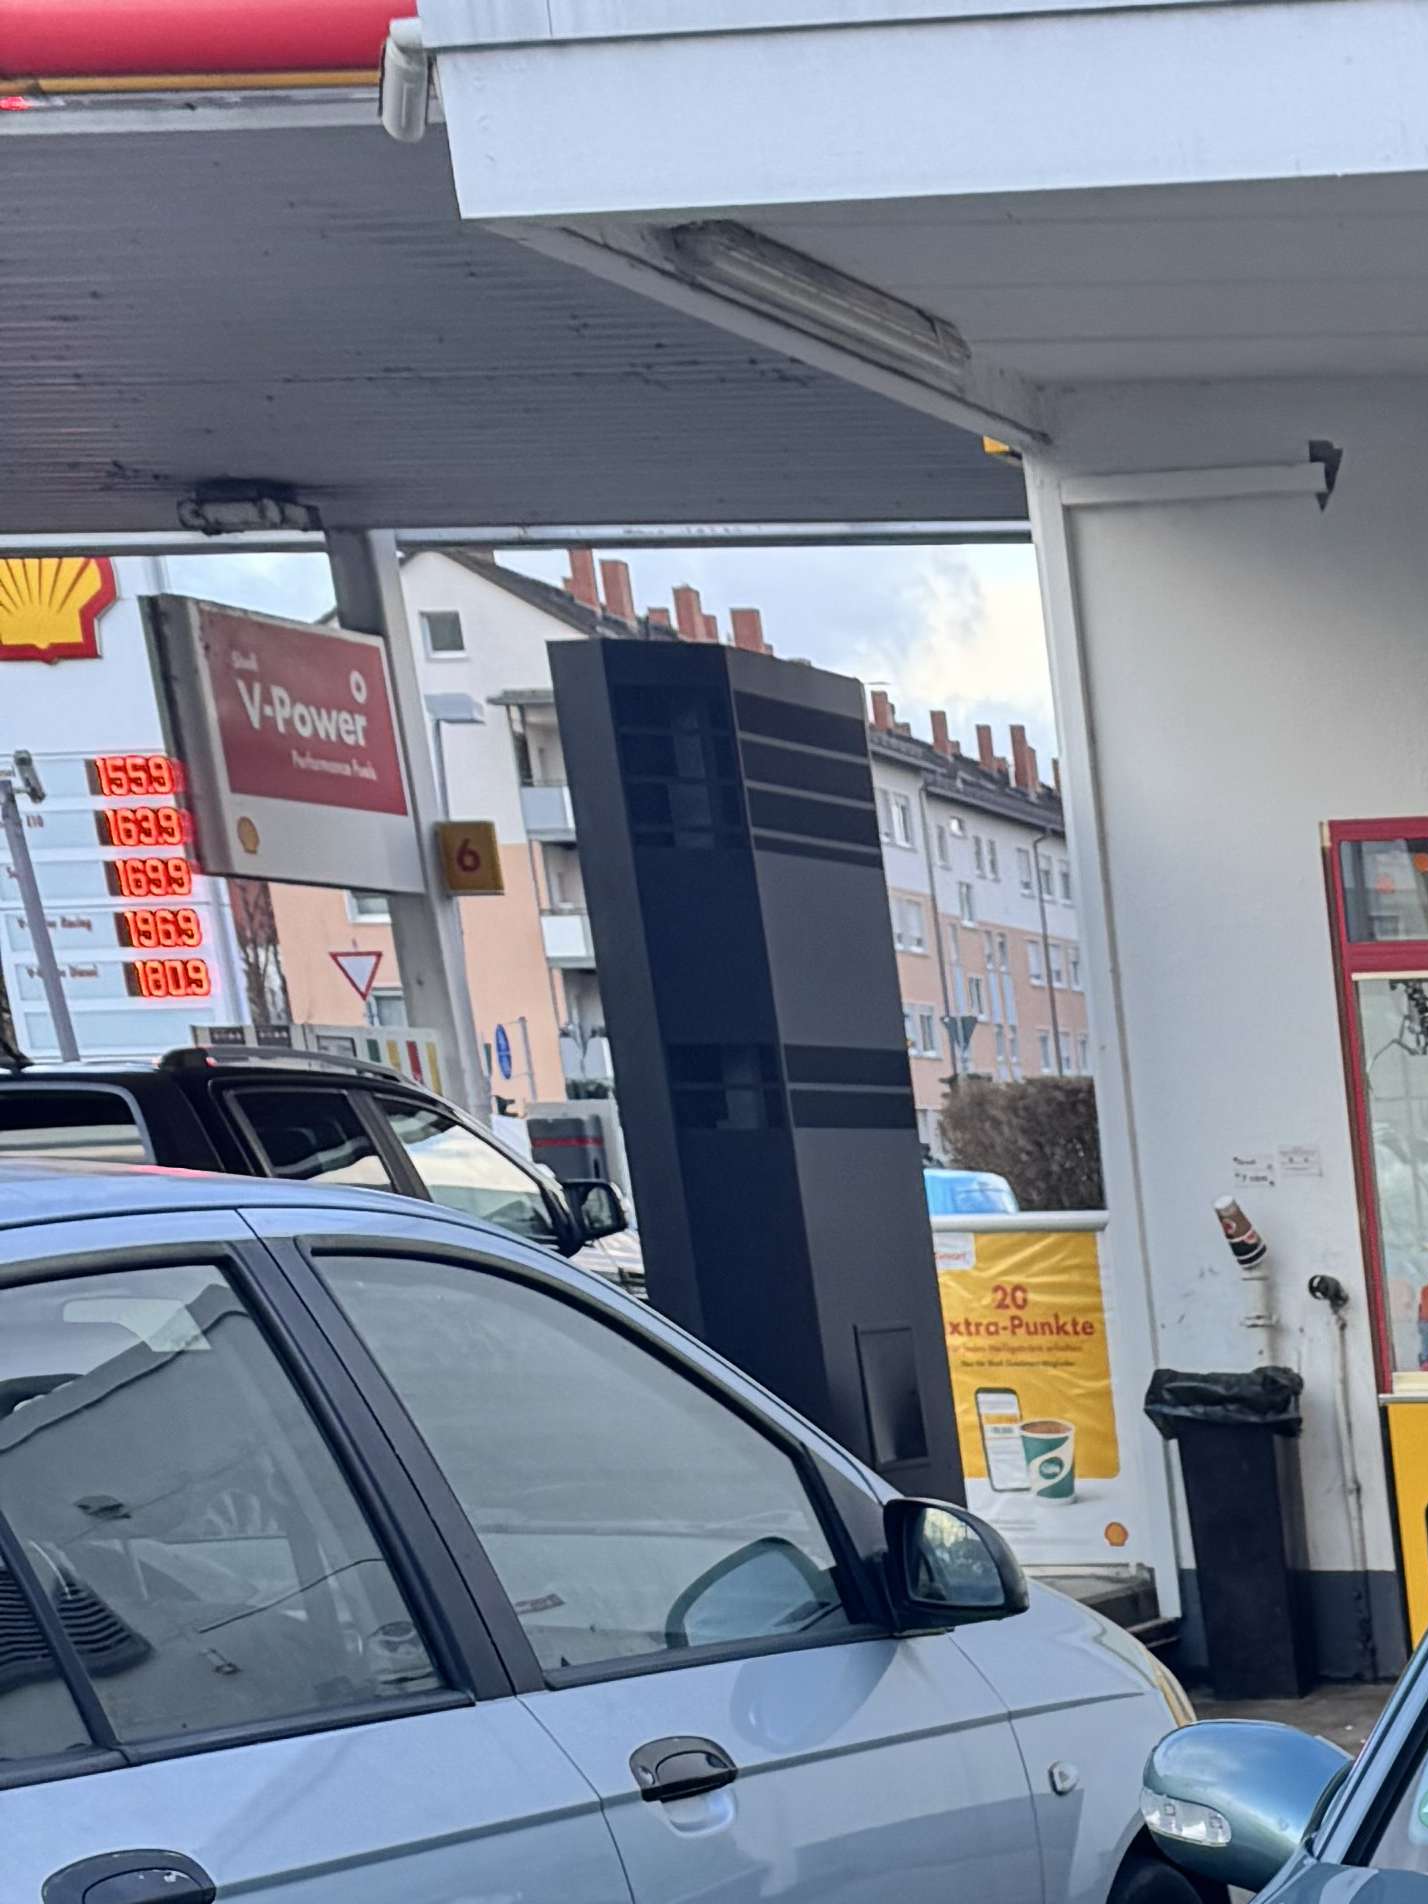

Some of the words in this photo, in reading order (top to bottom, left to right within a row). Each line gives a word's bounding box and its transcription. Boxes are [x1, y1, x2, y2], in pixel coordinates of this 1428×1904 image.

[235, 678, 367, 746] V-Power
[456, 838, 481, 872] 6
[992, 1284, 1028, 1310] 20
[949, 1312, 1095, 1336] xtra-Punkte
